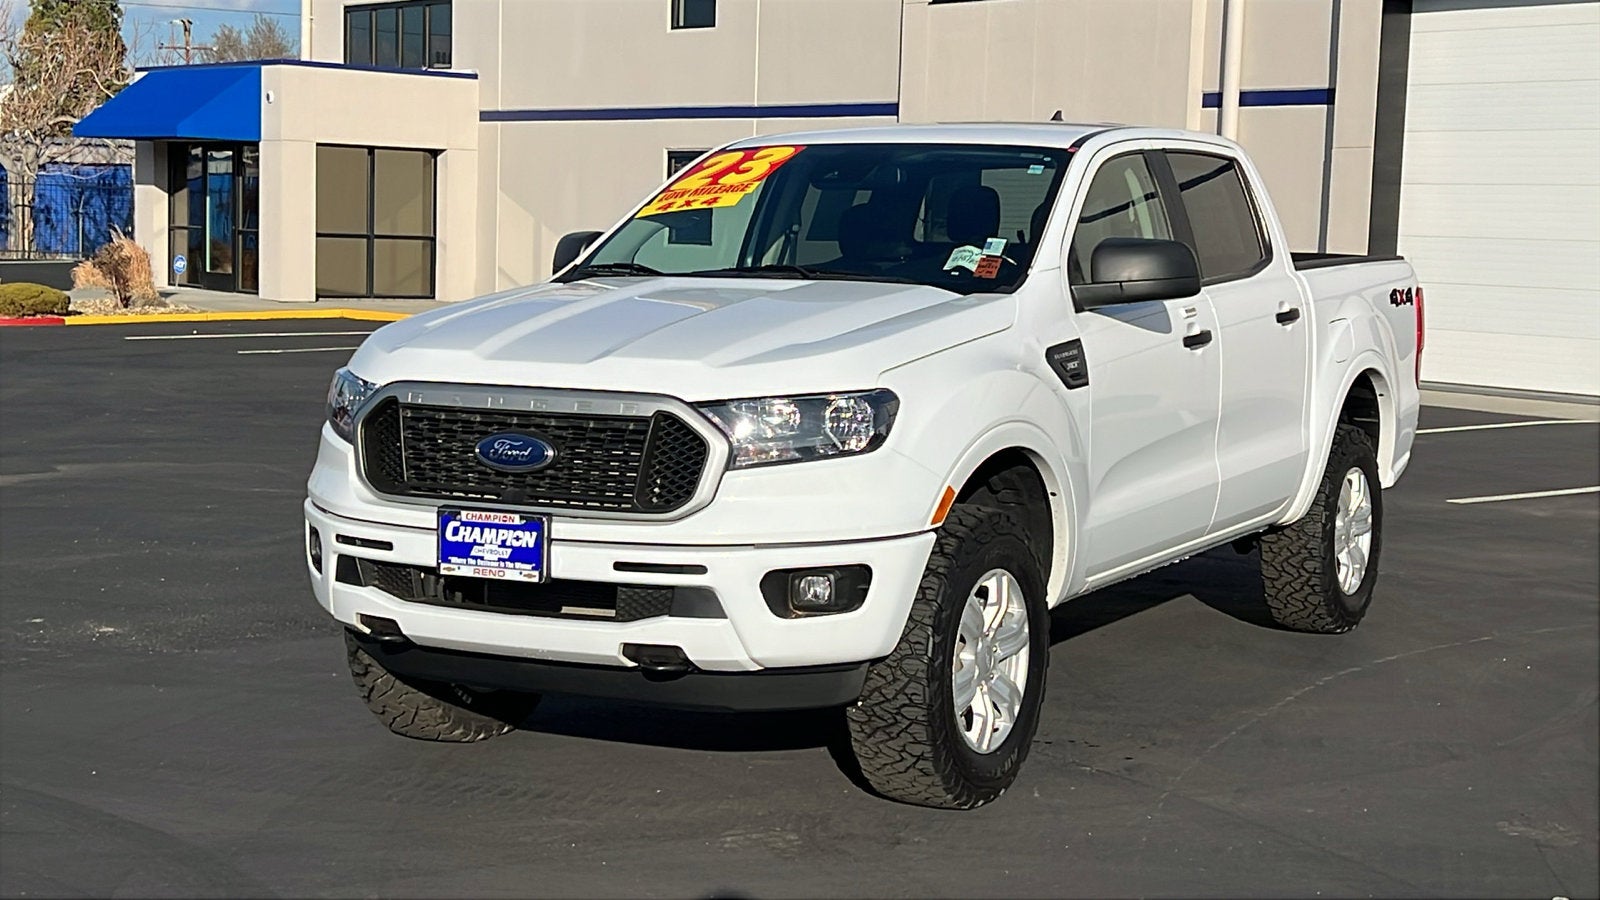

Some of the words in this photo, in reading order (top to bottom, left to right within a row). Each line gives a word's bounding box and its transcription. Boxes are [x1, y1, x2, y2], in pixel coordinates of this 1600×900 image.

[669, 146, 796, 191] 23
[657, 190, 687, 202] LOW
[688, 182, 754, 198] MILEAGE
[407, 392, 639, 414] RANGER
[490, 439, 532, 462] Ford
[465, 512, 516, 523] CHAMPION
[445, 520, 537, 548] CHAMPION
[473, 548, 508, 557] CHEVROLET
[472, 568, 506, 578] RENO
